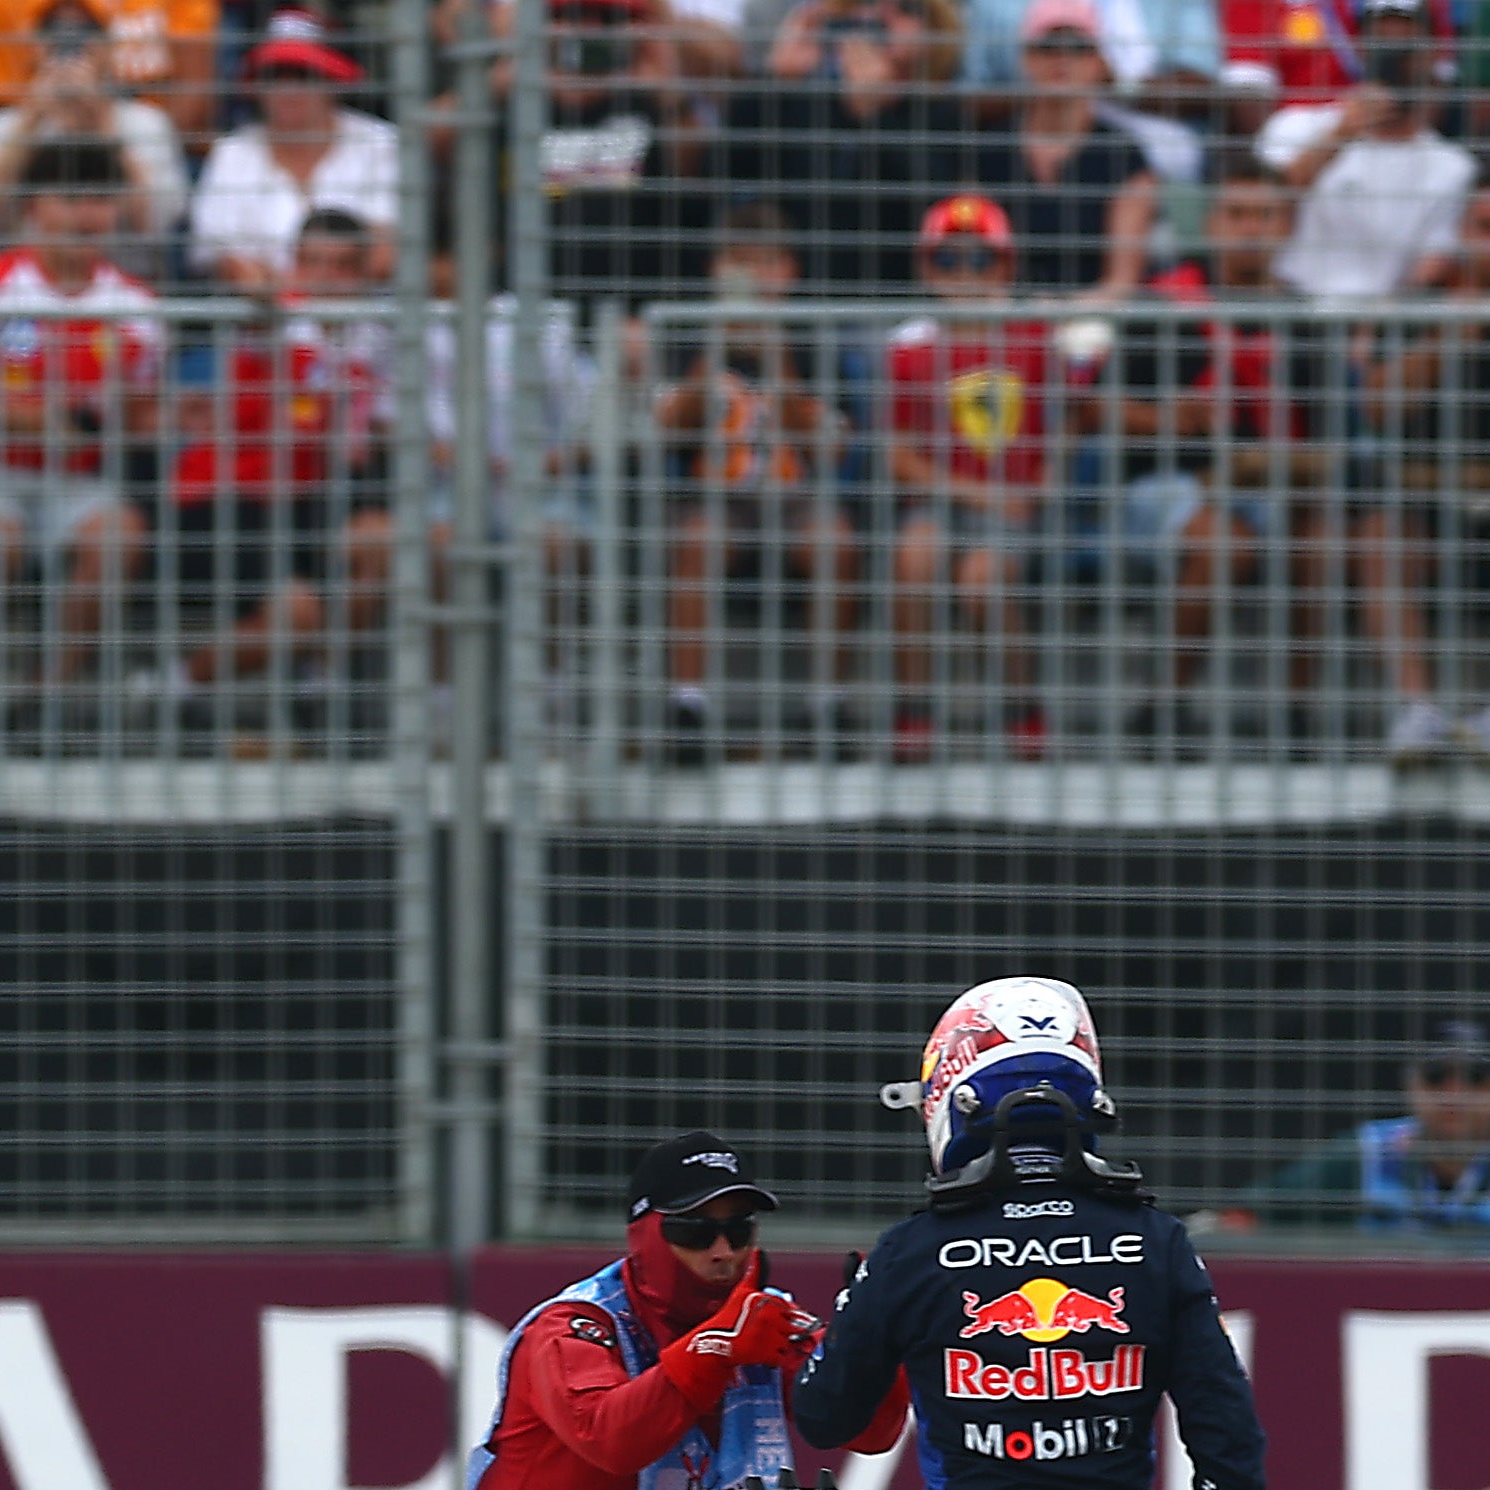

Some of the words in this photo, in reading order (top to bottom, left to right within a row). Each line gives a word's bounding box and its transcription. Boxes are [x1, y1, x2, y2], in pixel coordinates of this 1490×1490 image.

[938, 1234, 1145, 1269] ORACLE
[944, 1346, 1050, 1401] Red
[1050, 1344, 1147, 1400] Bull
[963, 1417, 1089, 1461] Mobil
